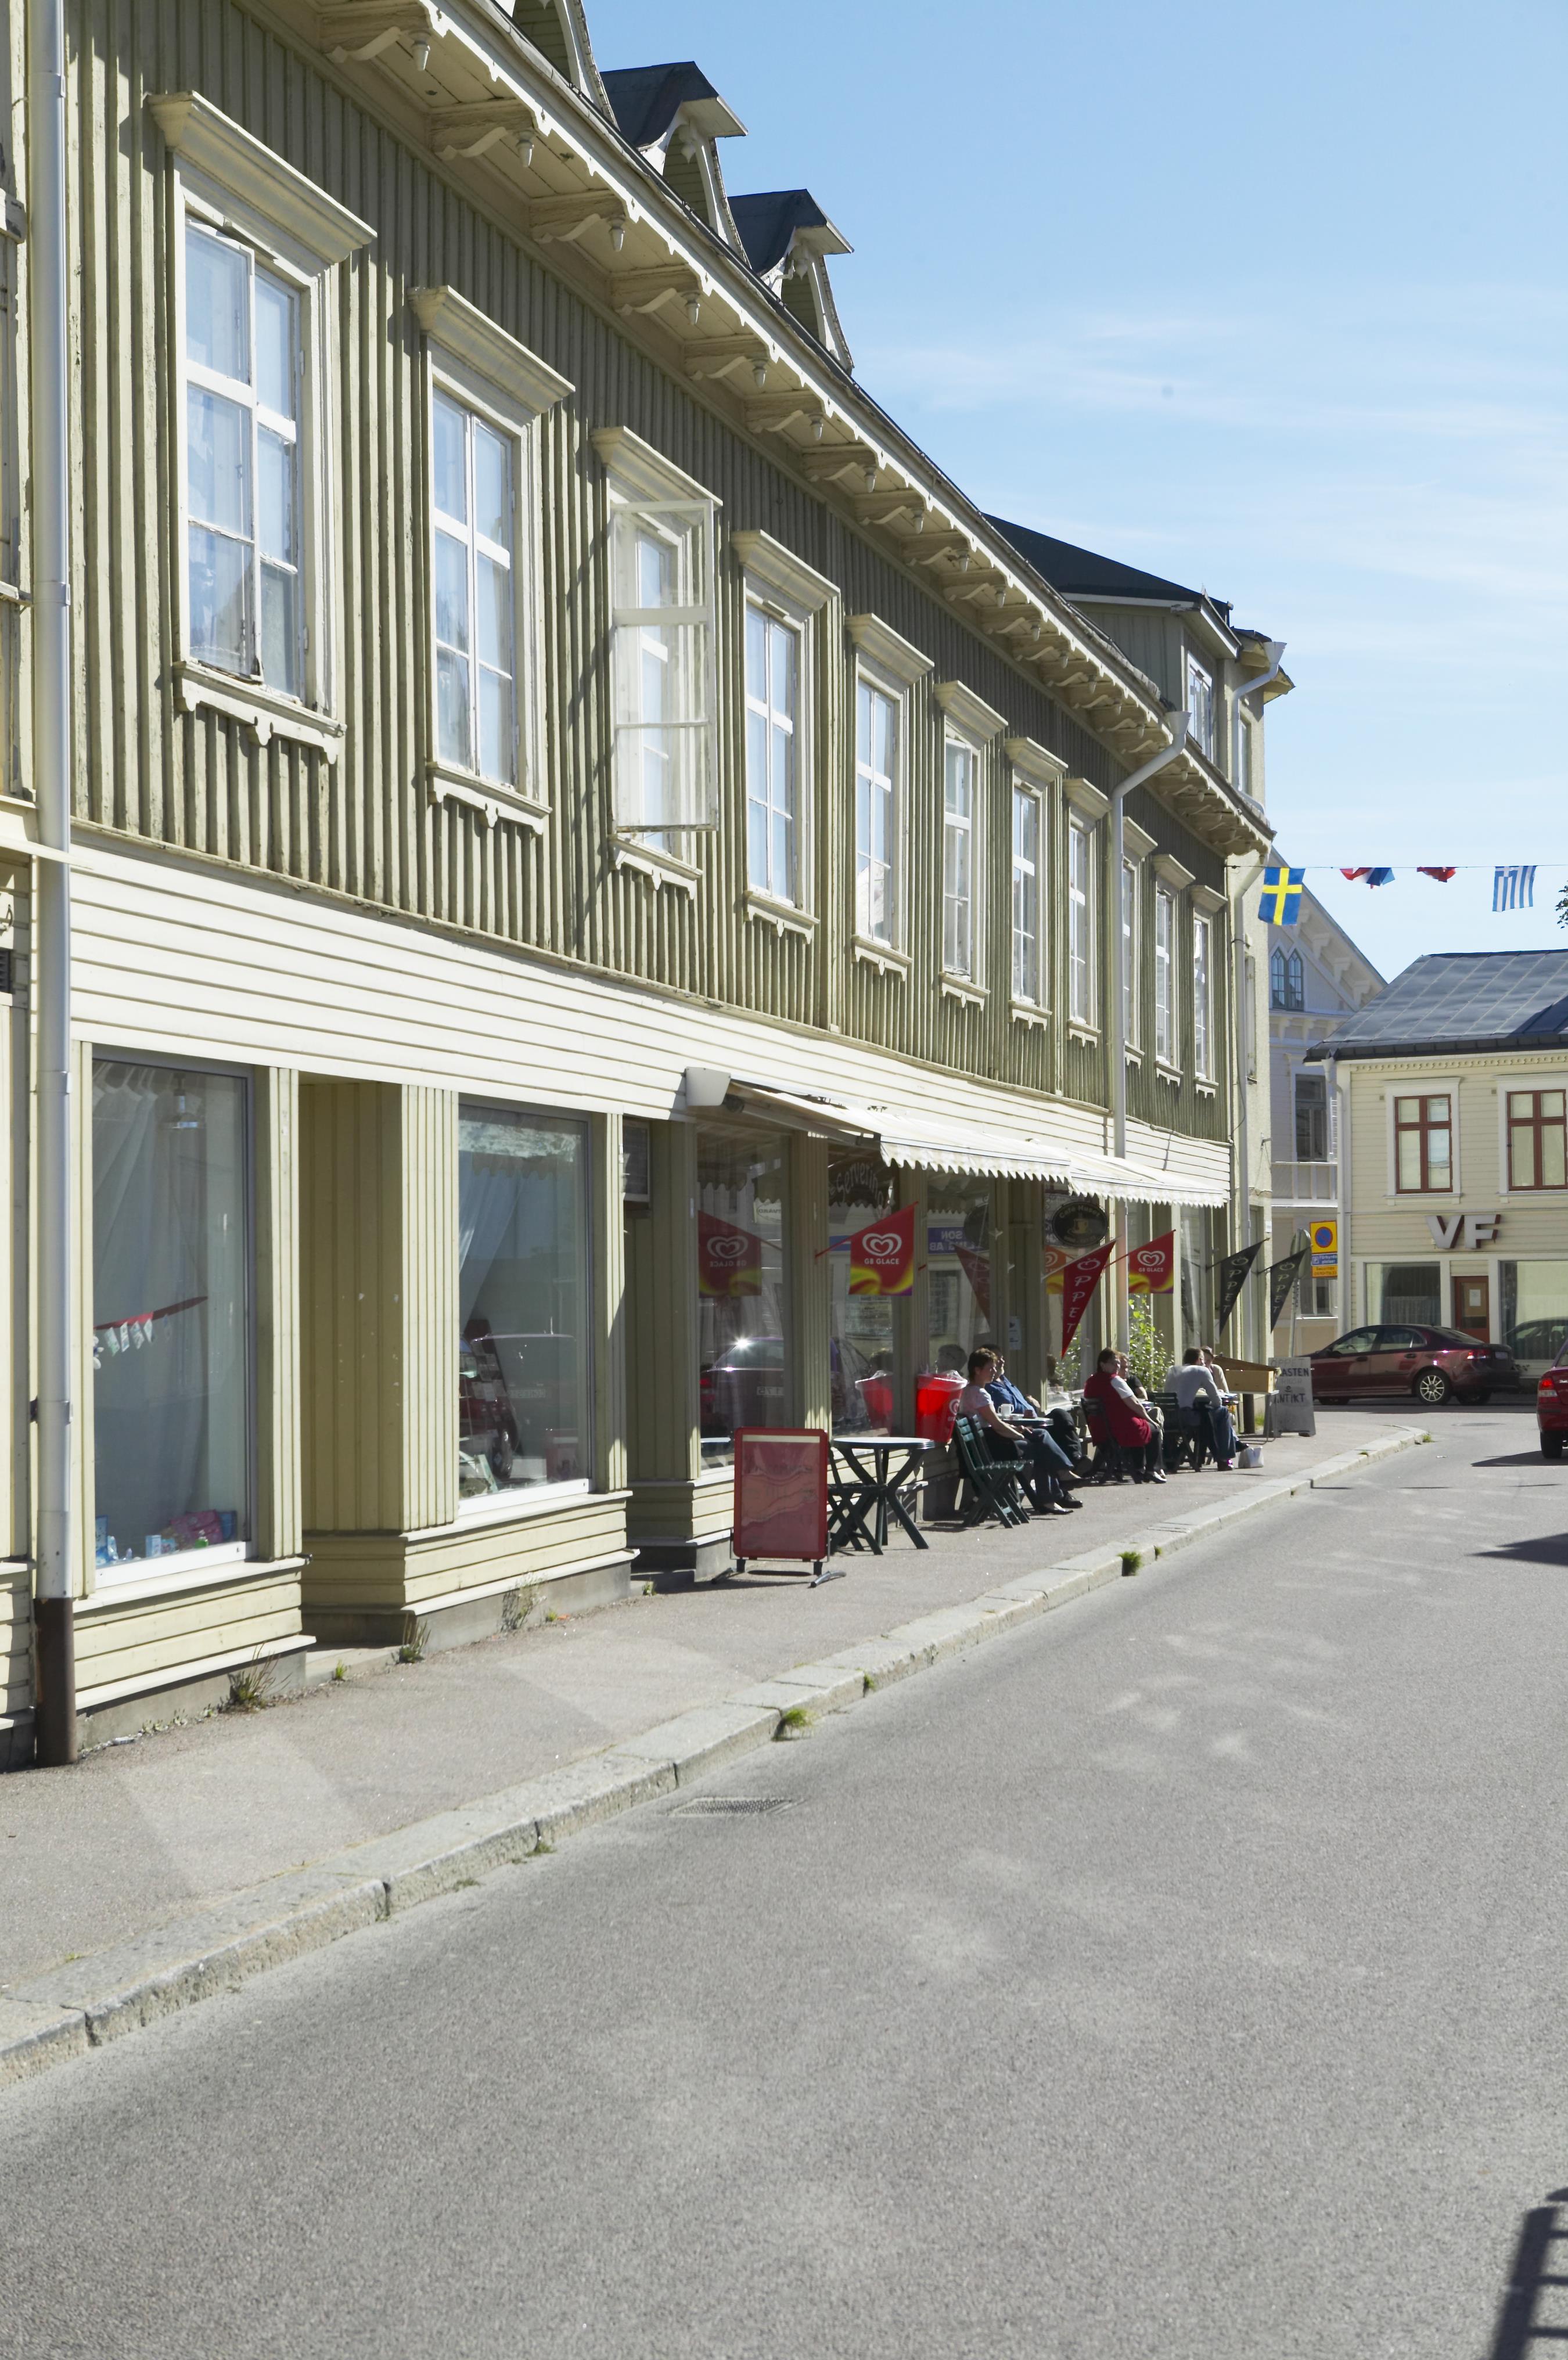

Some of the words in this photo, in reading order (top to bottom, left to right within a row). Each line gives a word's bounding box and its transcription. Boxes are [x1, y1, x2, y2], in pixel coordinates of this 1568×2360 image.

[1425, 1214, 1501, 1249] VF
[1067, 1258, 1101, 1334] ÖPPET
[1223, 1256, 1249, 1313] ÖPPET
[1273, 1262, 1296, 1314] ÖPPET
